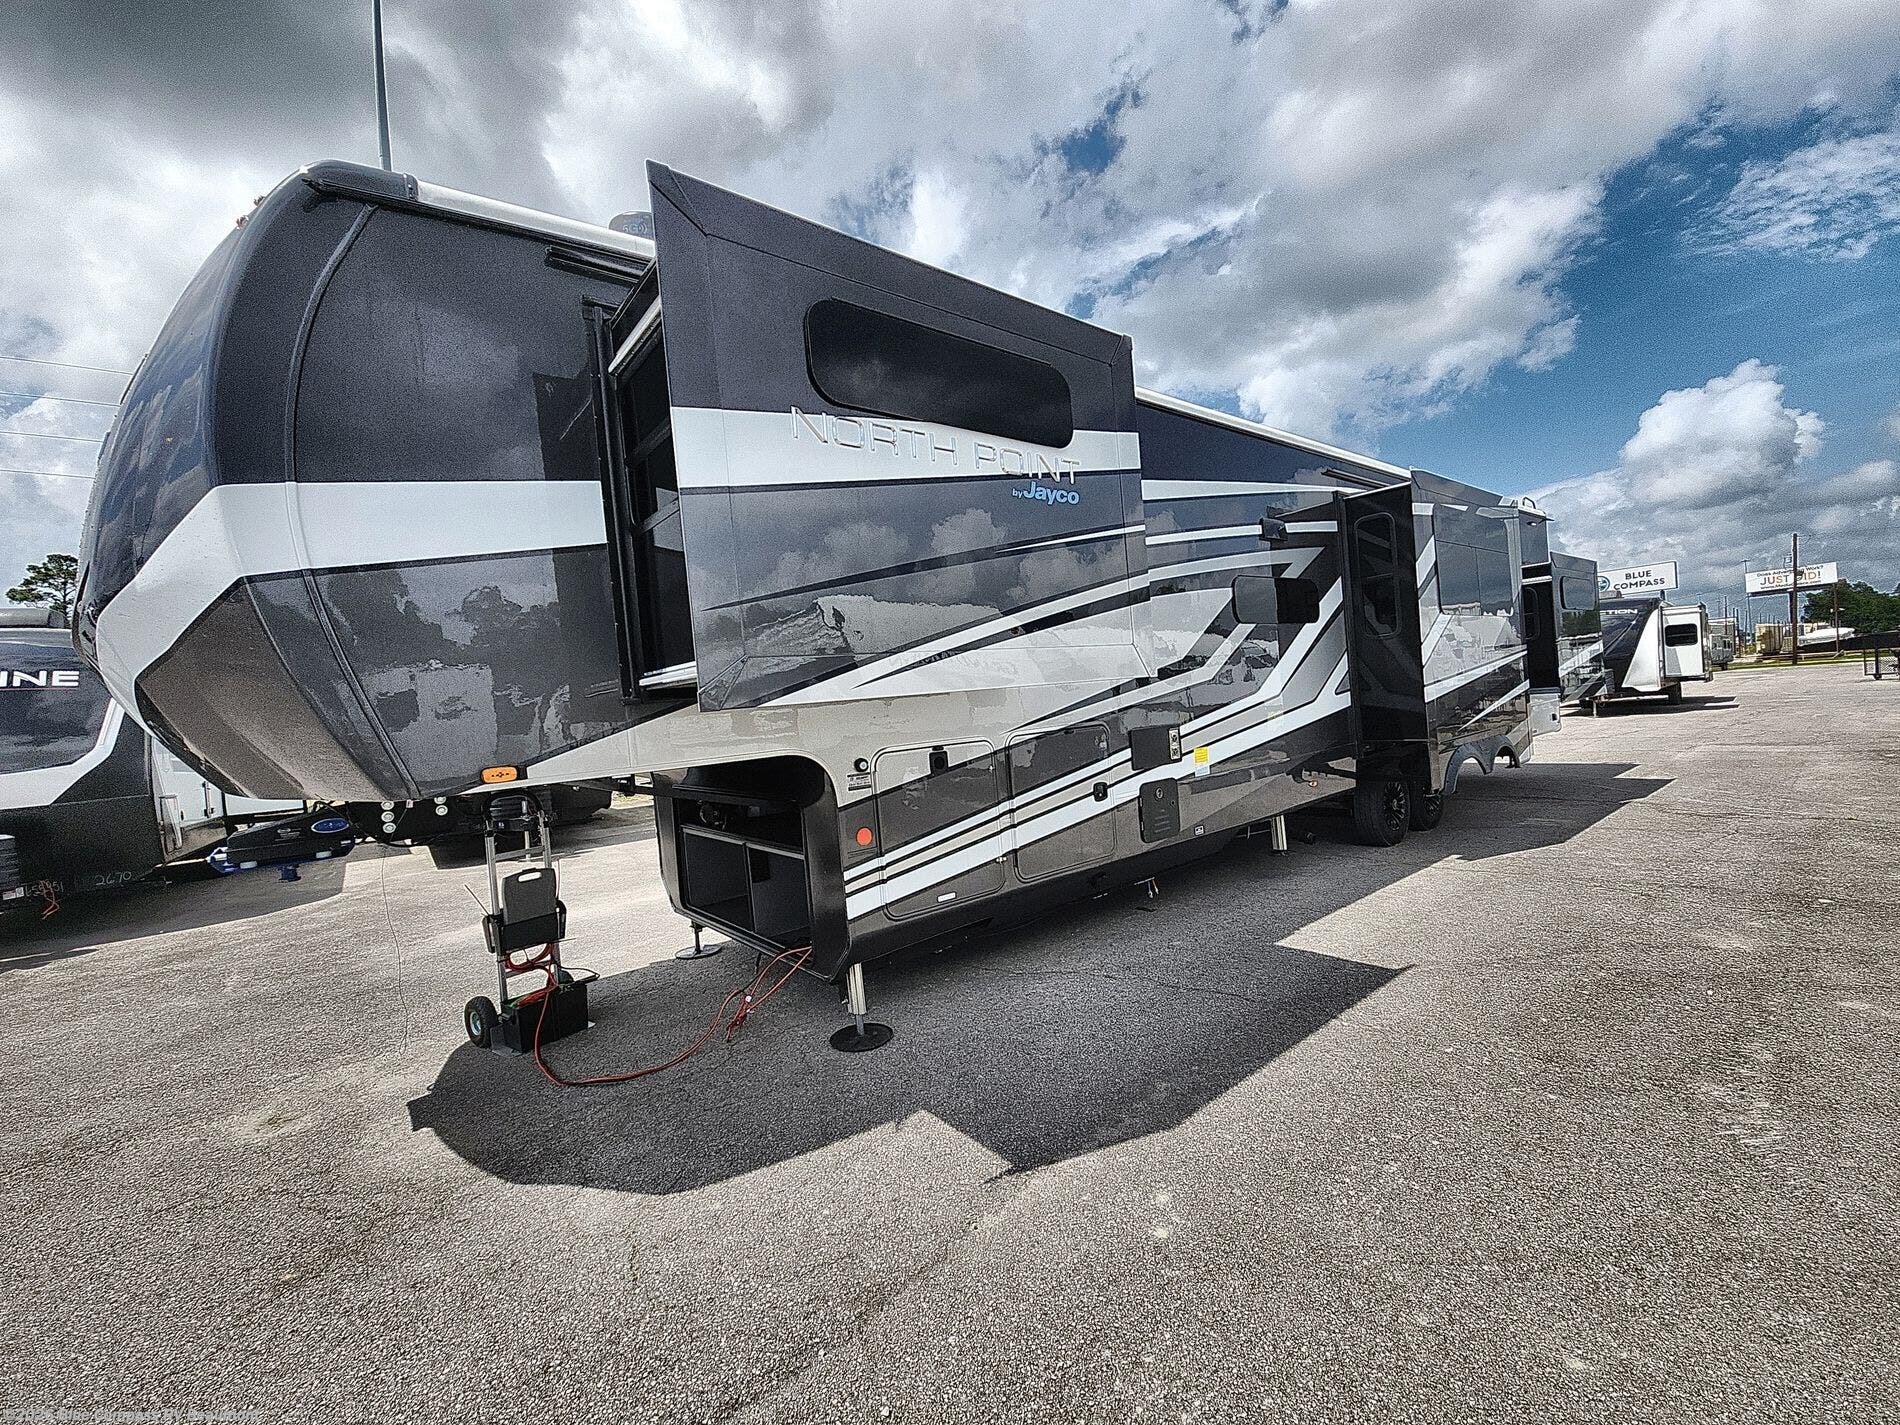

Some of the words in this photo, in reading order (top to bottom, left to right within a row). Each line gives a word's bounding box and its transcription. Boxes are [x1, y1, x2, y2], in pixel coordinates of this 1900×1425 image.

[791, 406, 957, 465] NORTH
[975, 442, 1080, 484] POINT
[1012, 488, 1022, 498] by
[1023, 482, 1079, 504] Jayco
[1625, 570, 1652, 580] BLUE
[1760, 575, 1789, 586] JUST
[1613, 578, 1665, 591] COMPASS
[95, 871, 132, 886] 2670
